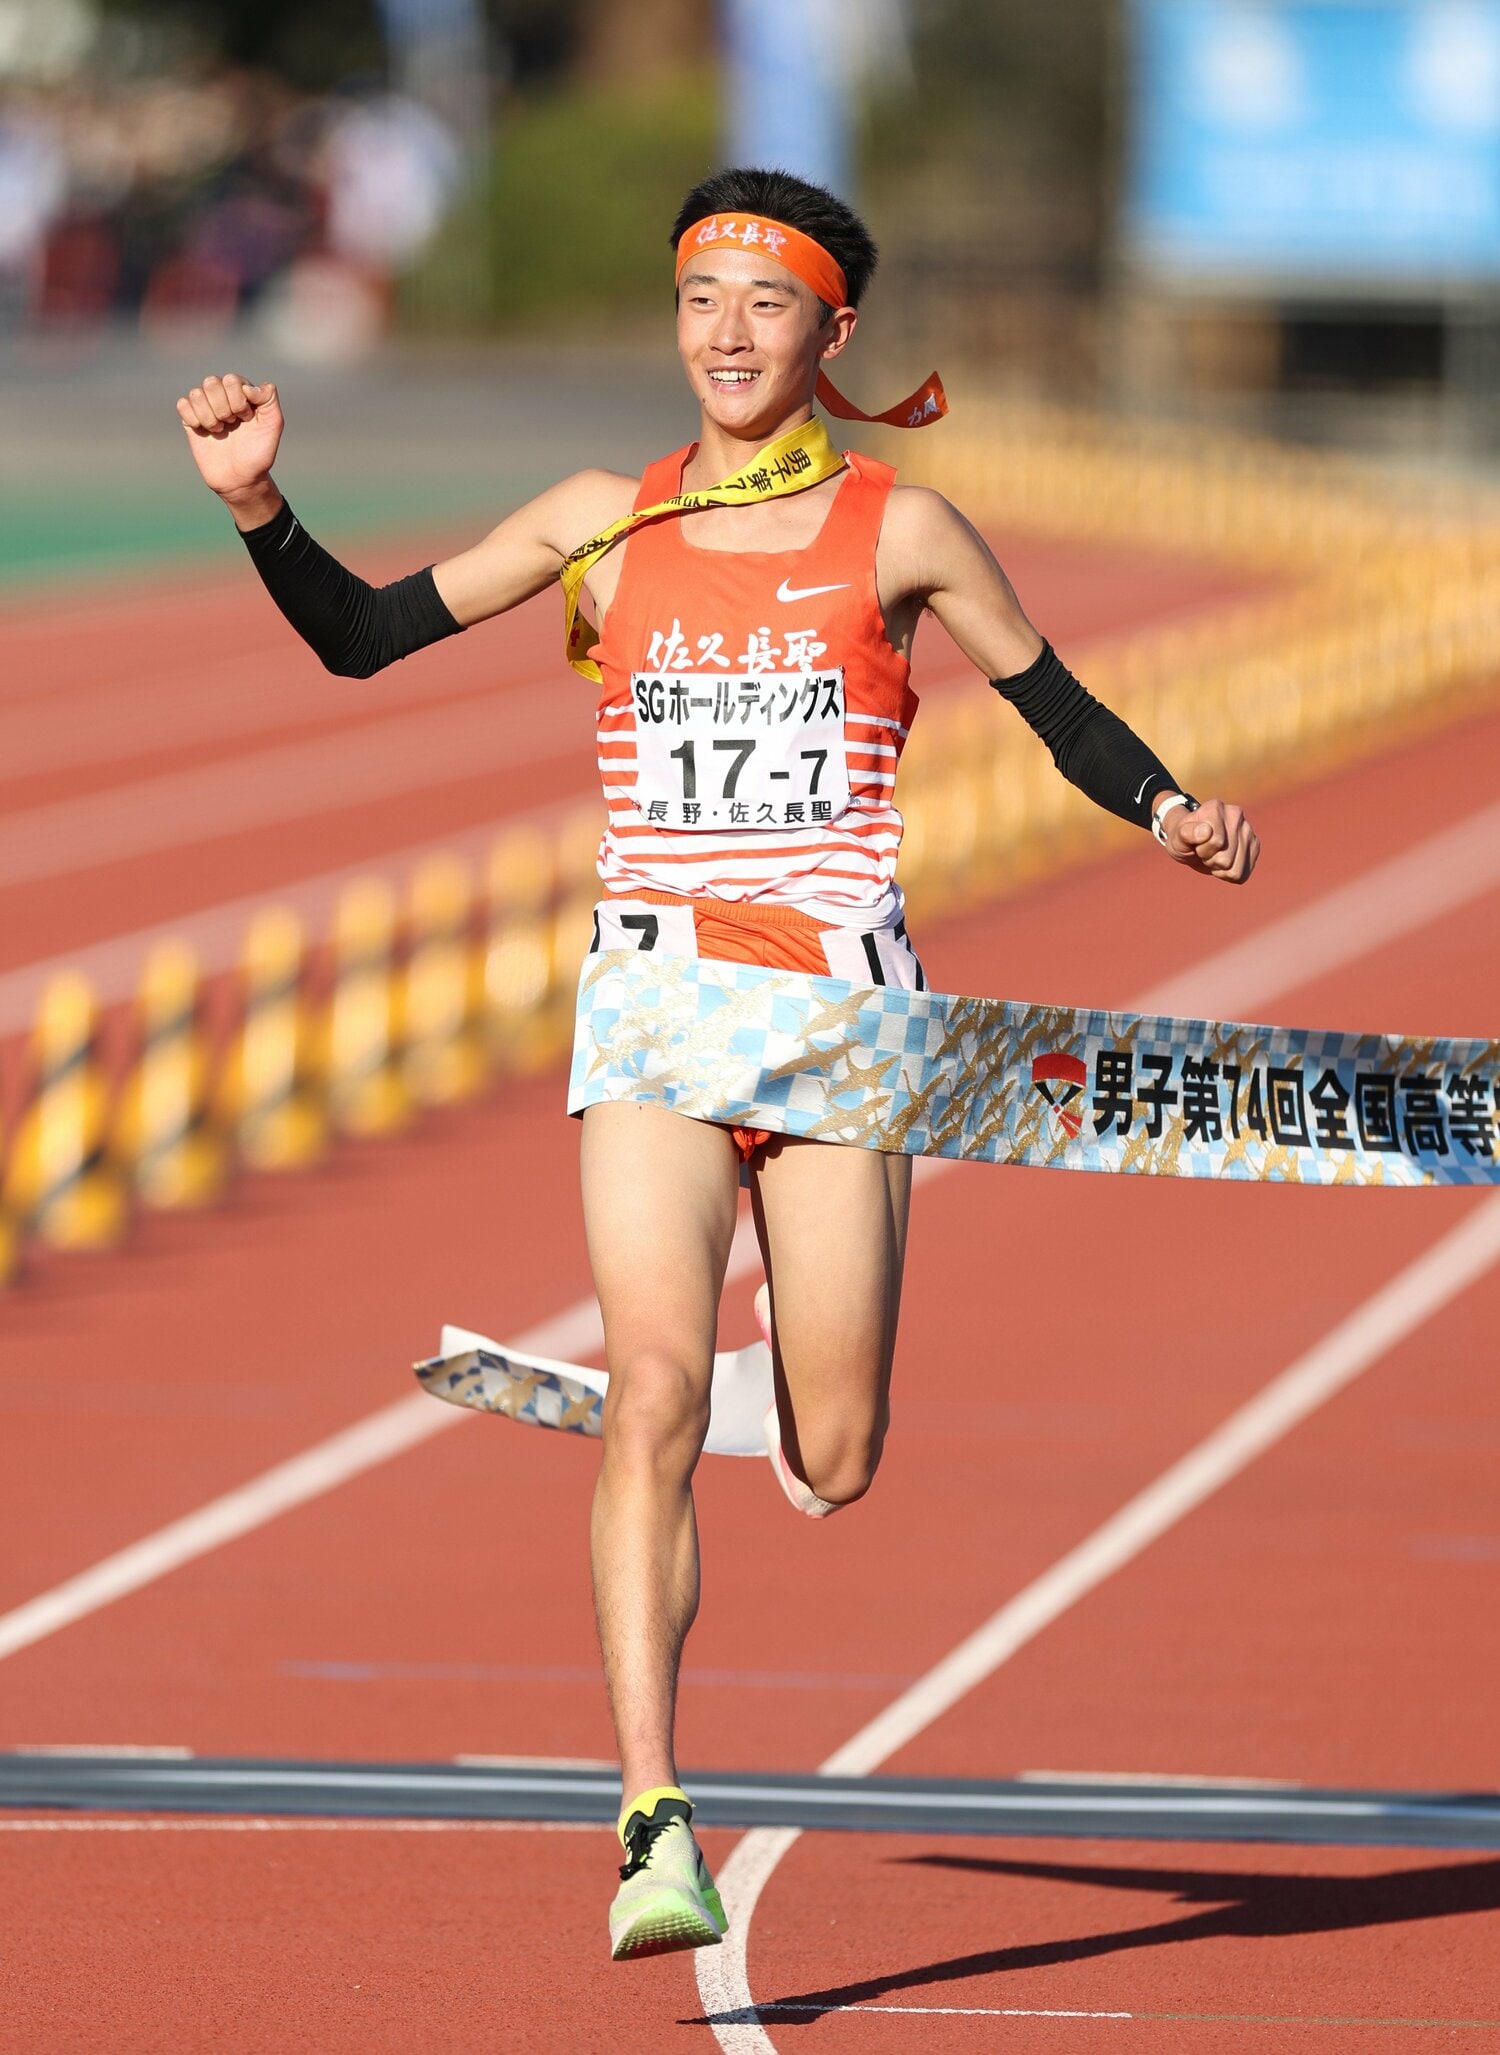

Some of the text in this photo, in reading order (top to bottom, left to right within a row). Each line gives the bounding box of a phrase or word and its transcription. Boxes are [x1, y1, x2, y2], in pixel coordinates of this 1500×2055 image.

[647, 617, 828, 674] 佐久長聖
[635, 677, 841, 726] SGホールディングス
[647, 800, 833, 825] 長野・佐久長聖
[1092, 1049, 1500, 1157] 男子第74回全国高等
